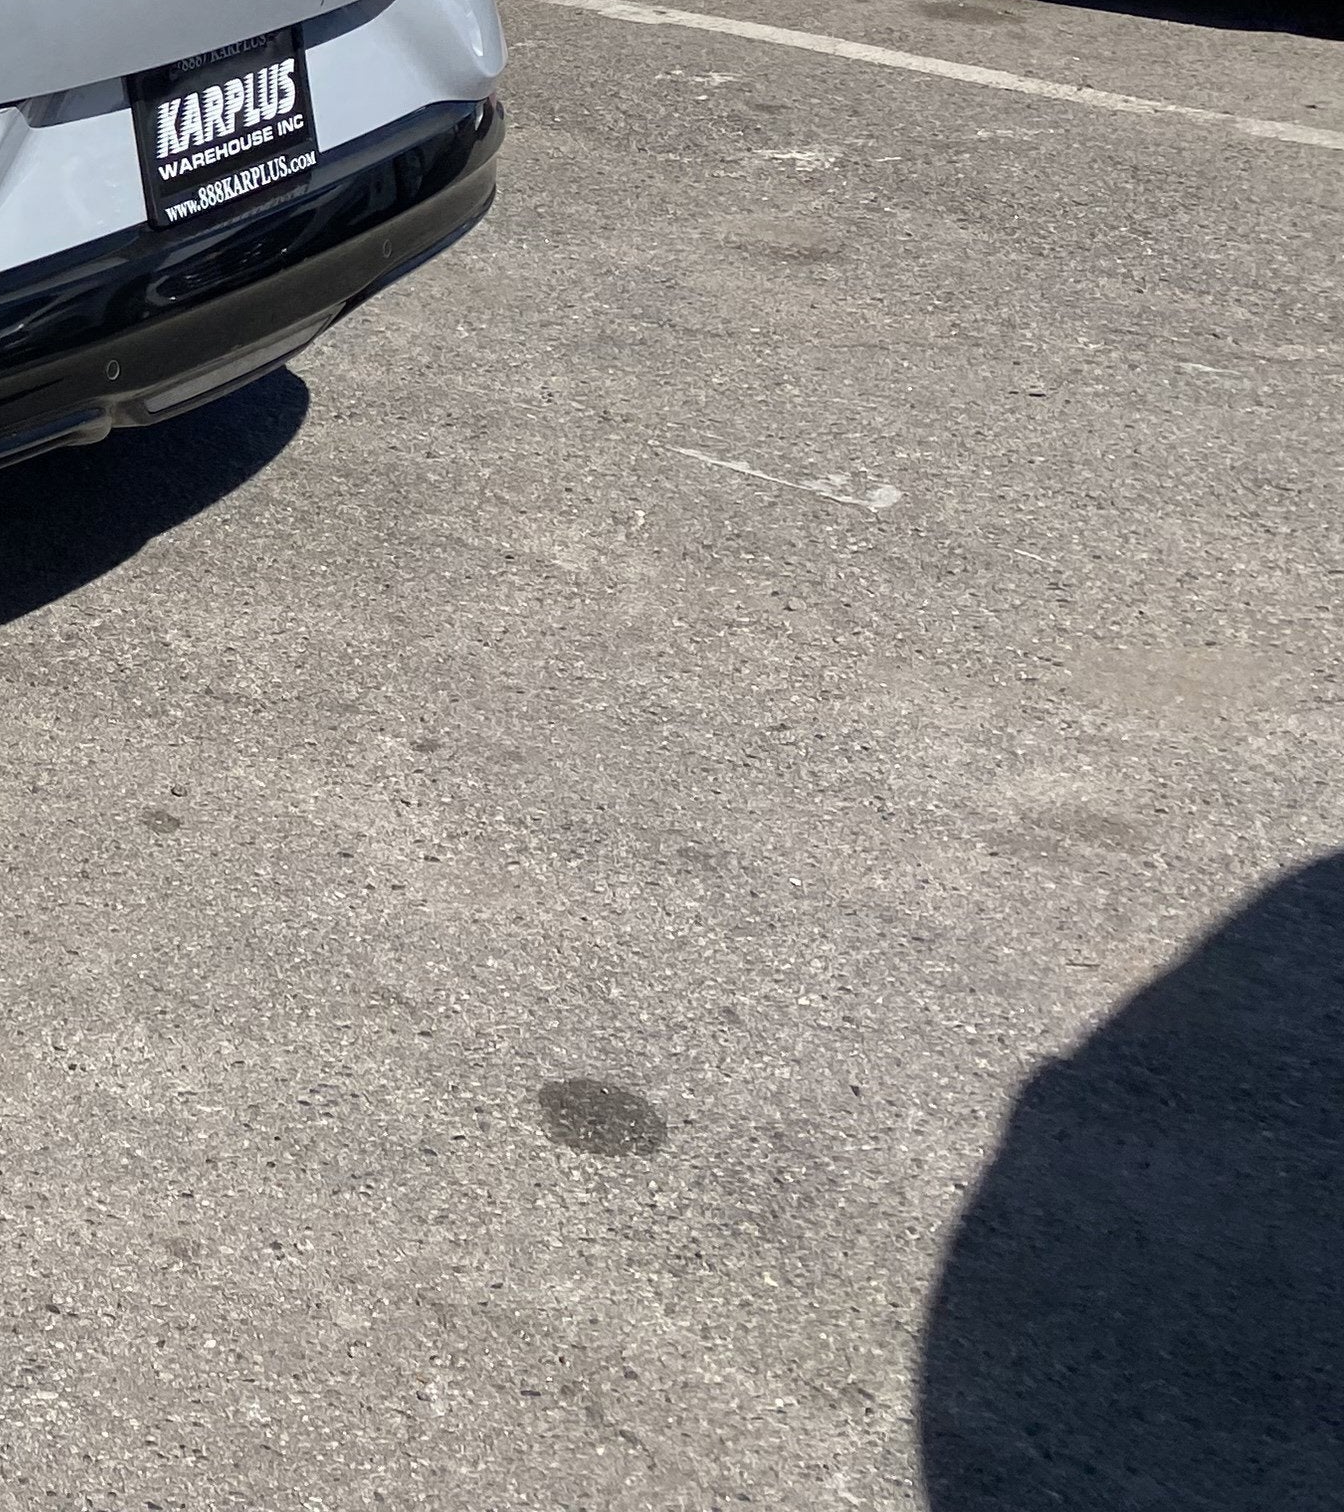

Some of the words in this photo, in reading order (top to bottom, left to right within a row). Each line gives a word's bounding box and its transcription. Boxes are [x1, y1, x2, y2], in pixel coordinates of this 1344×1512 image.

[156, 57, 295, 159] KARPLUS
[158, 125, 274, 180] WAREHOUSE
[277, 113, 305, 136] INC
